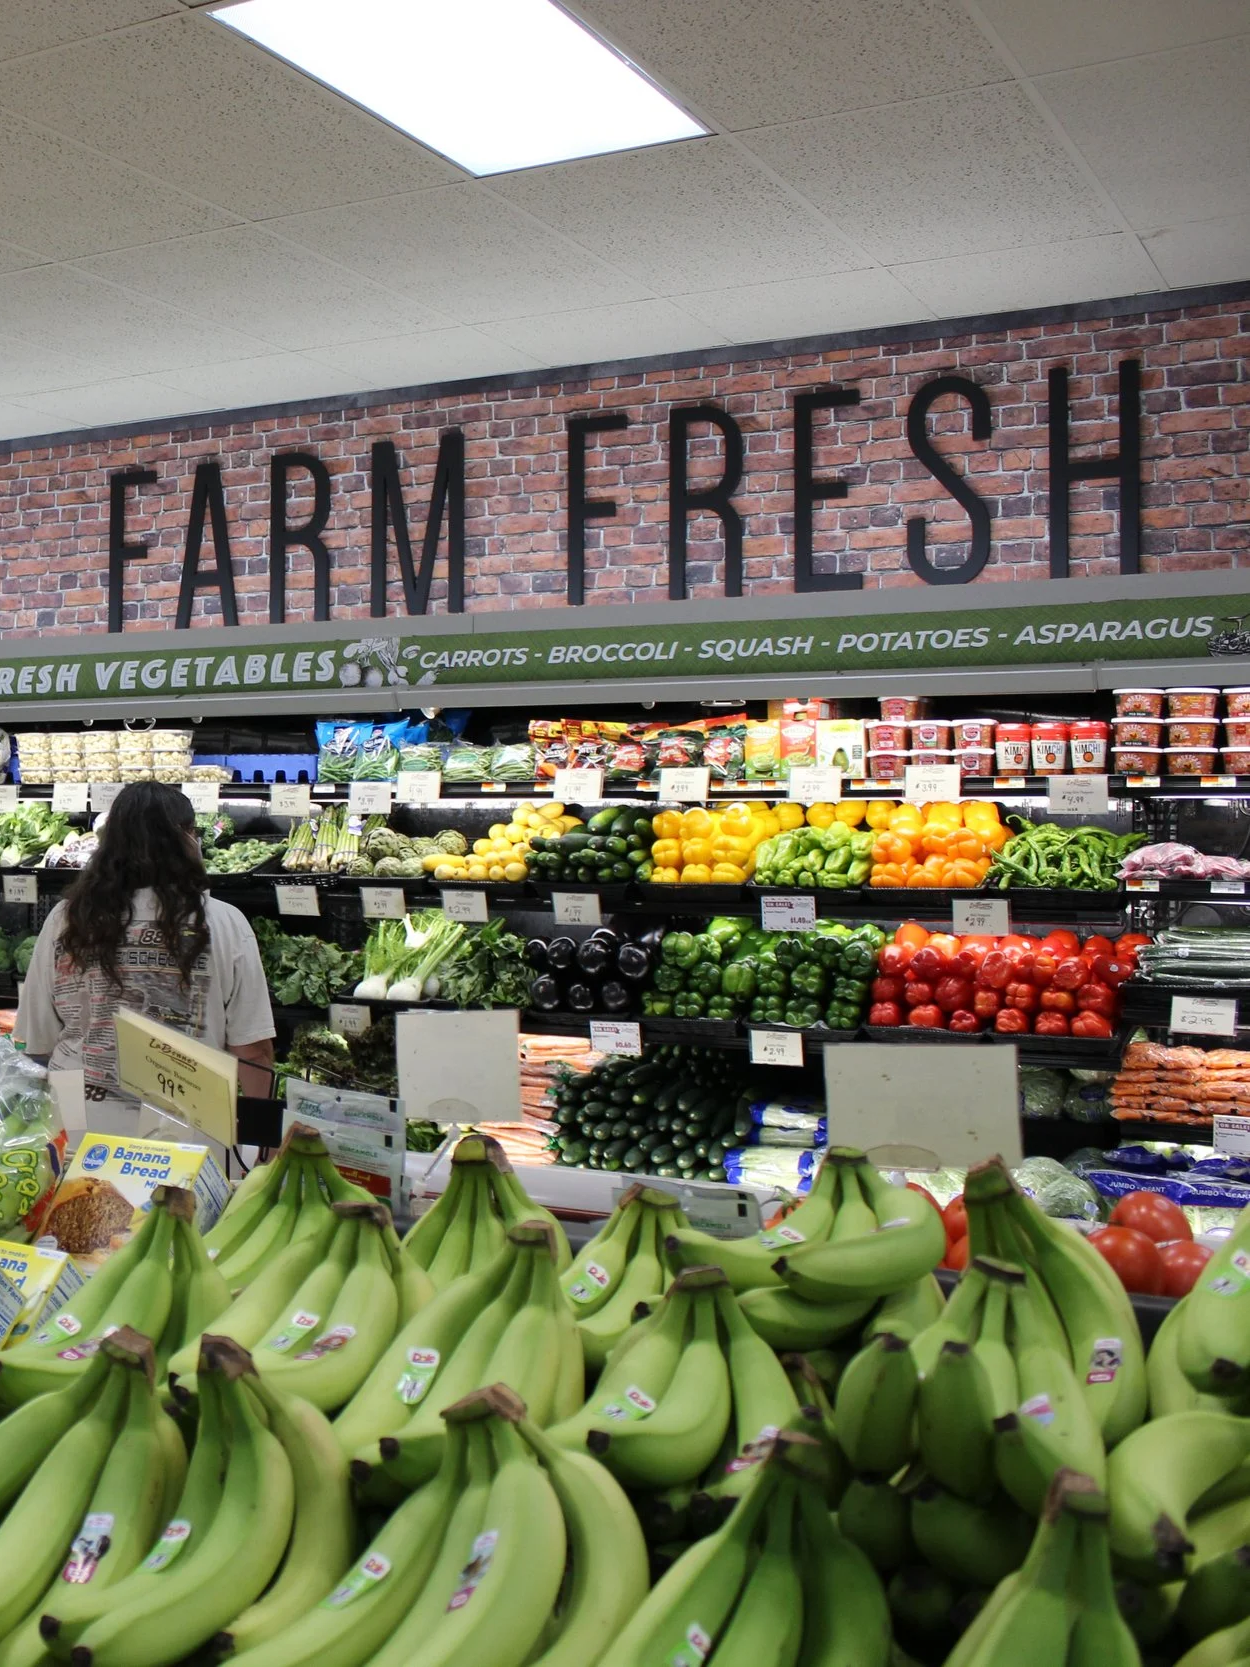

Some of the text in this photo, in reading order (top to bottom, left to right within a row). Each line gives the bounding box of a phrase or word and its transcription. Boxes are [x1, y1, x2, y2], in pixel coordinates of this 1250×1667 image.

[107, 359, 1141, 634] FARM FRESH
[419, 646, 529, 669] CARROTS
[547, 641, 679, 664] BROCCOLI
[697, 635, 814, 661] SQUASH
[837, 627, 991, 653] POTATOES
[1013, 616, 1215, 646] ASPARAGUS
[95, 649, 337, 691] VEGETABLES
[1036, 744, 1063, 754] KIMCHI
[1074, 743, 1101, 753] KIMCHI
[141, 929, 164, 945] 88
[113, 1147, 171, 1165] Banana
[120, 1162, 171, 1180] Bread
[144, 1180, 158, 1189] Mi
[1109, 1180, 1135, 1191] JUMBO
[5, 1283, 25, 1307] Facts
[411, 1352, 436, 1363] Dole
